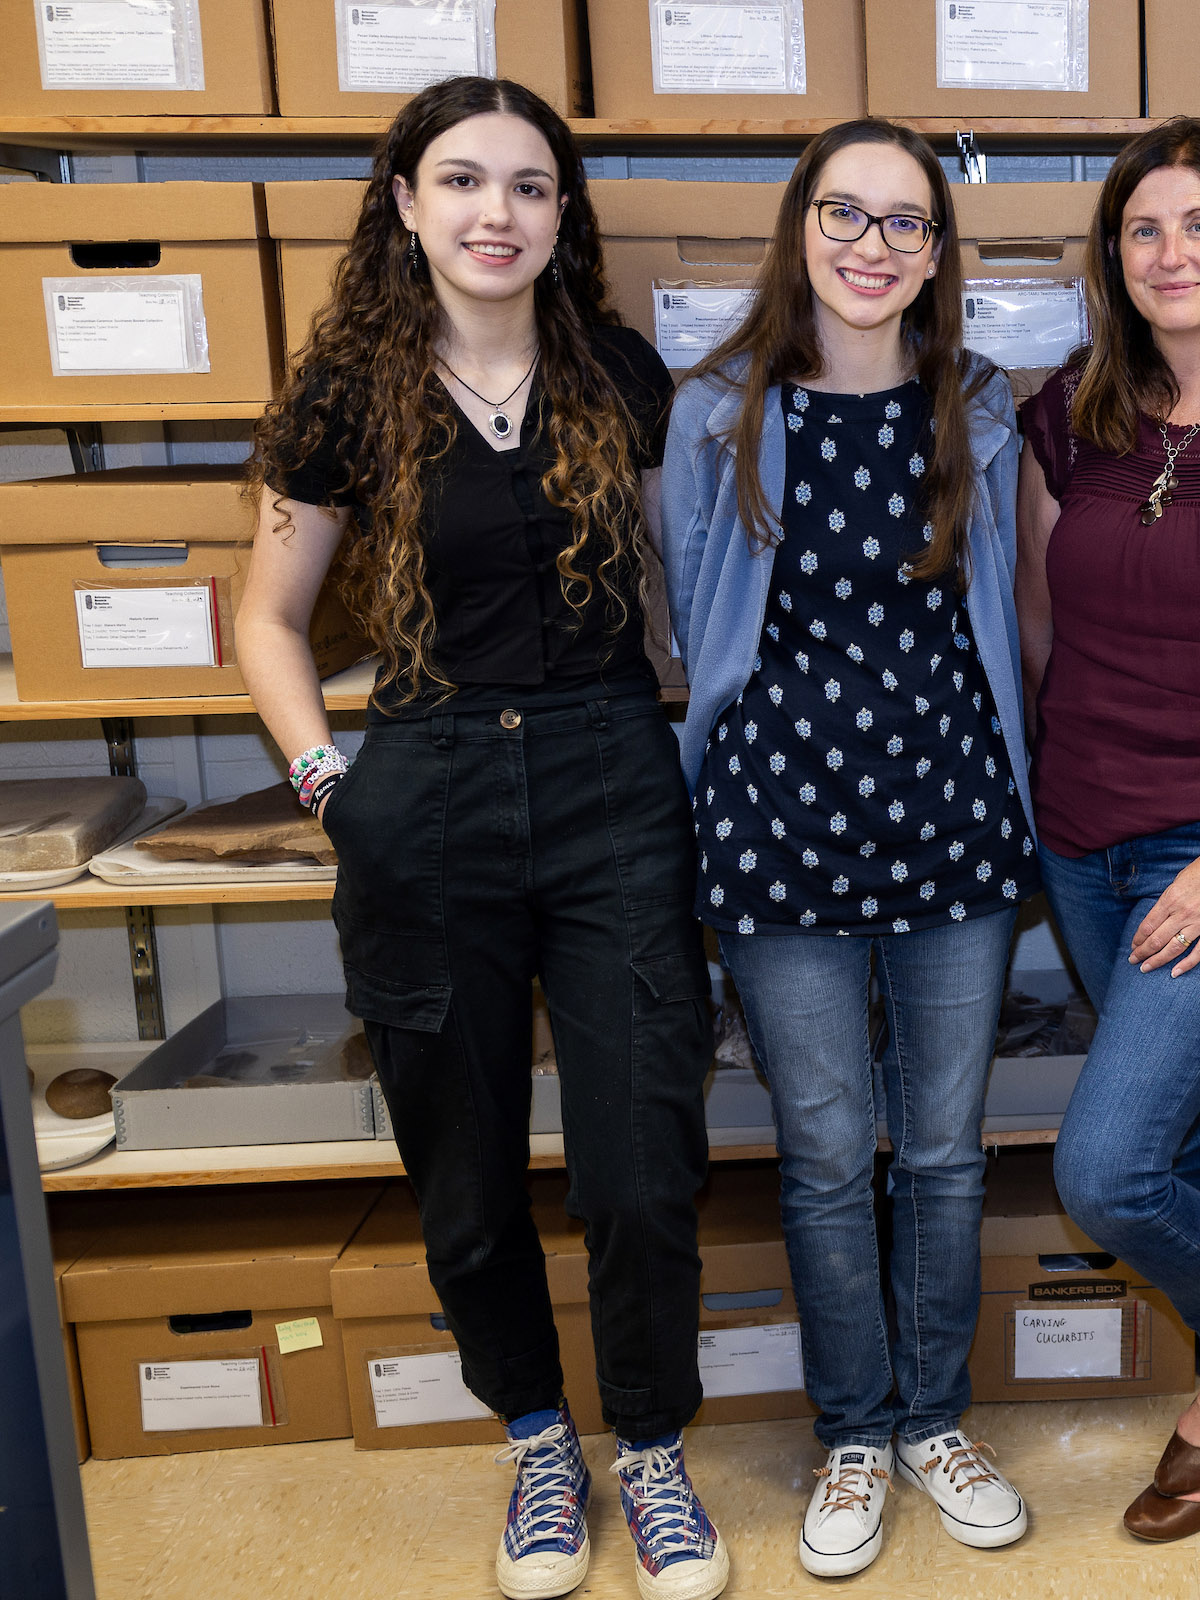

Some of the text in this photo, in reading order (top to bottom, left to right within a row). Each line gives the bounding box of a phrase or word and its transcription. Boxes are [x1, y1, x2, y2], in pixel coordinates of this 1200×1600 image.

[1034, 1285, 1122, 1296] BANKERS BOX
[1022, 1316, 1067, 1328] CARVING
[1036, 1331, 1095, 1343] CUCURBITS
